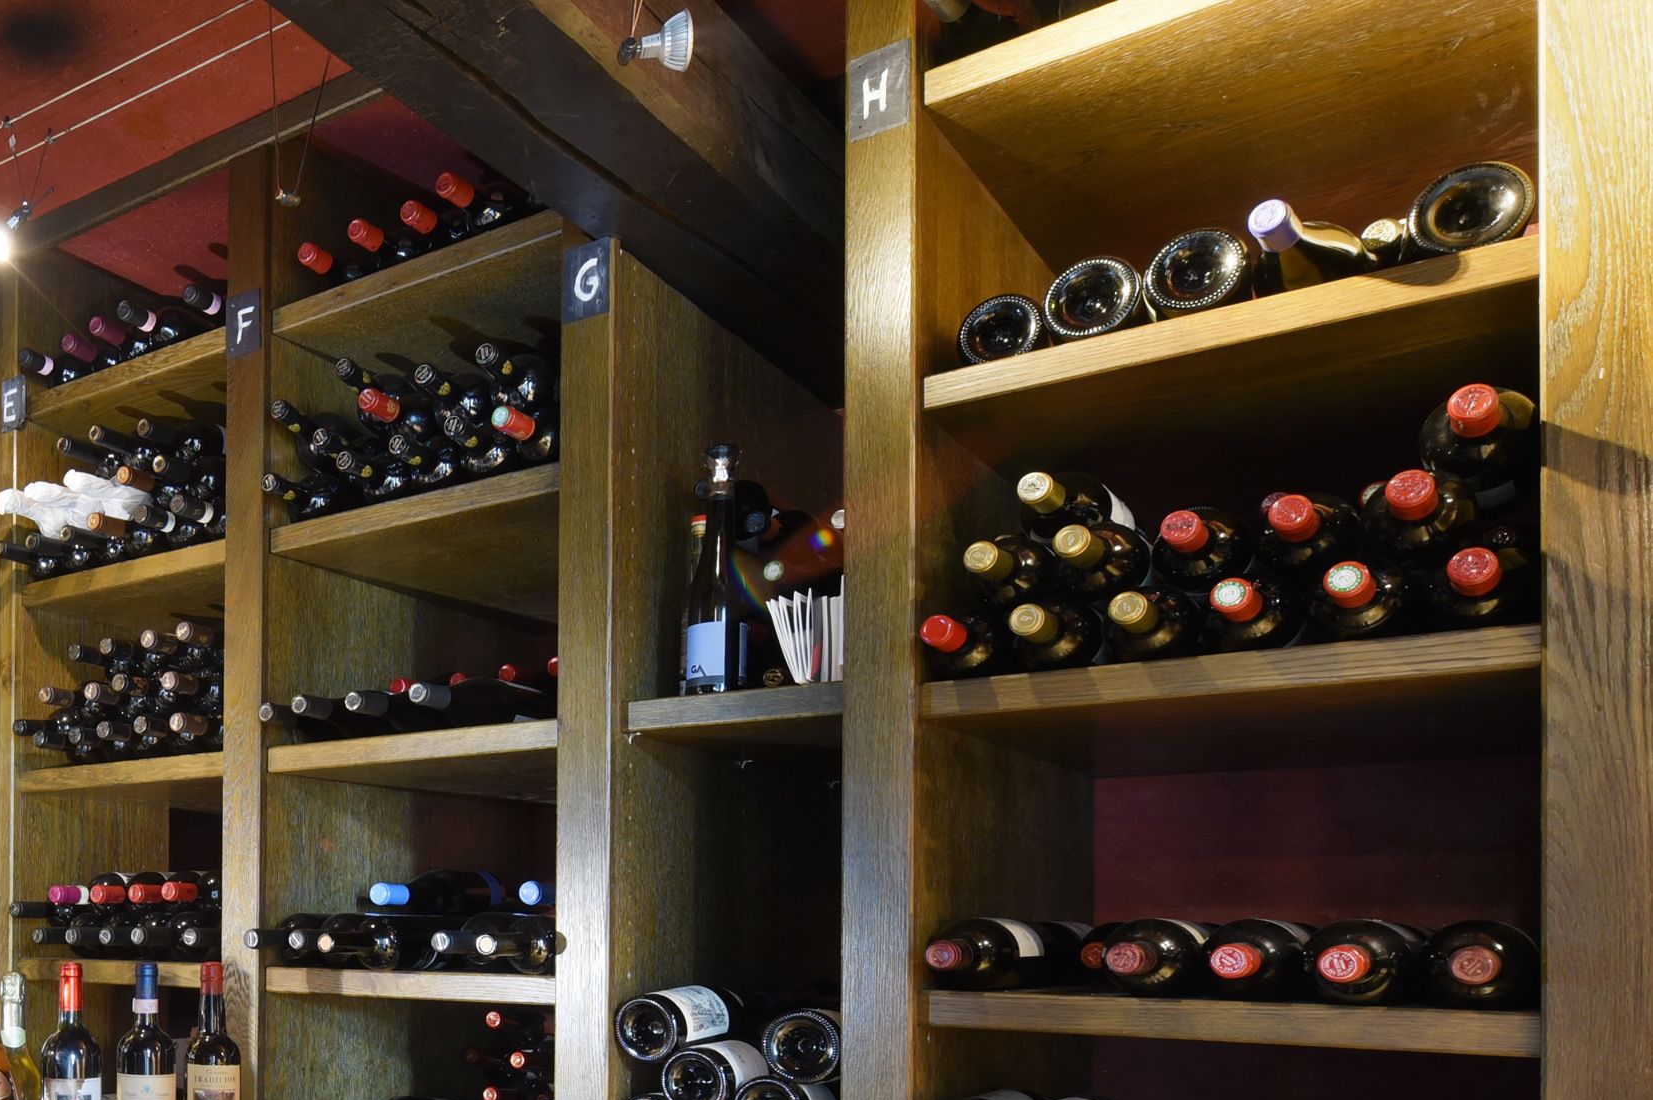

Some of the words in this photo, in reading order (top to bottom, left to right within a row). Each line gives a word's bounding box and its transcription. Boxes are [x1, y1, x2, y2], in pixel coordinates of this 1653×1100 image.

[861, 67, 890, 121] H
[573, 256, 600, 303] G
[235, 303, 256, 345] F
[3, 386, 17, 423] E
